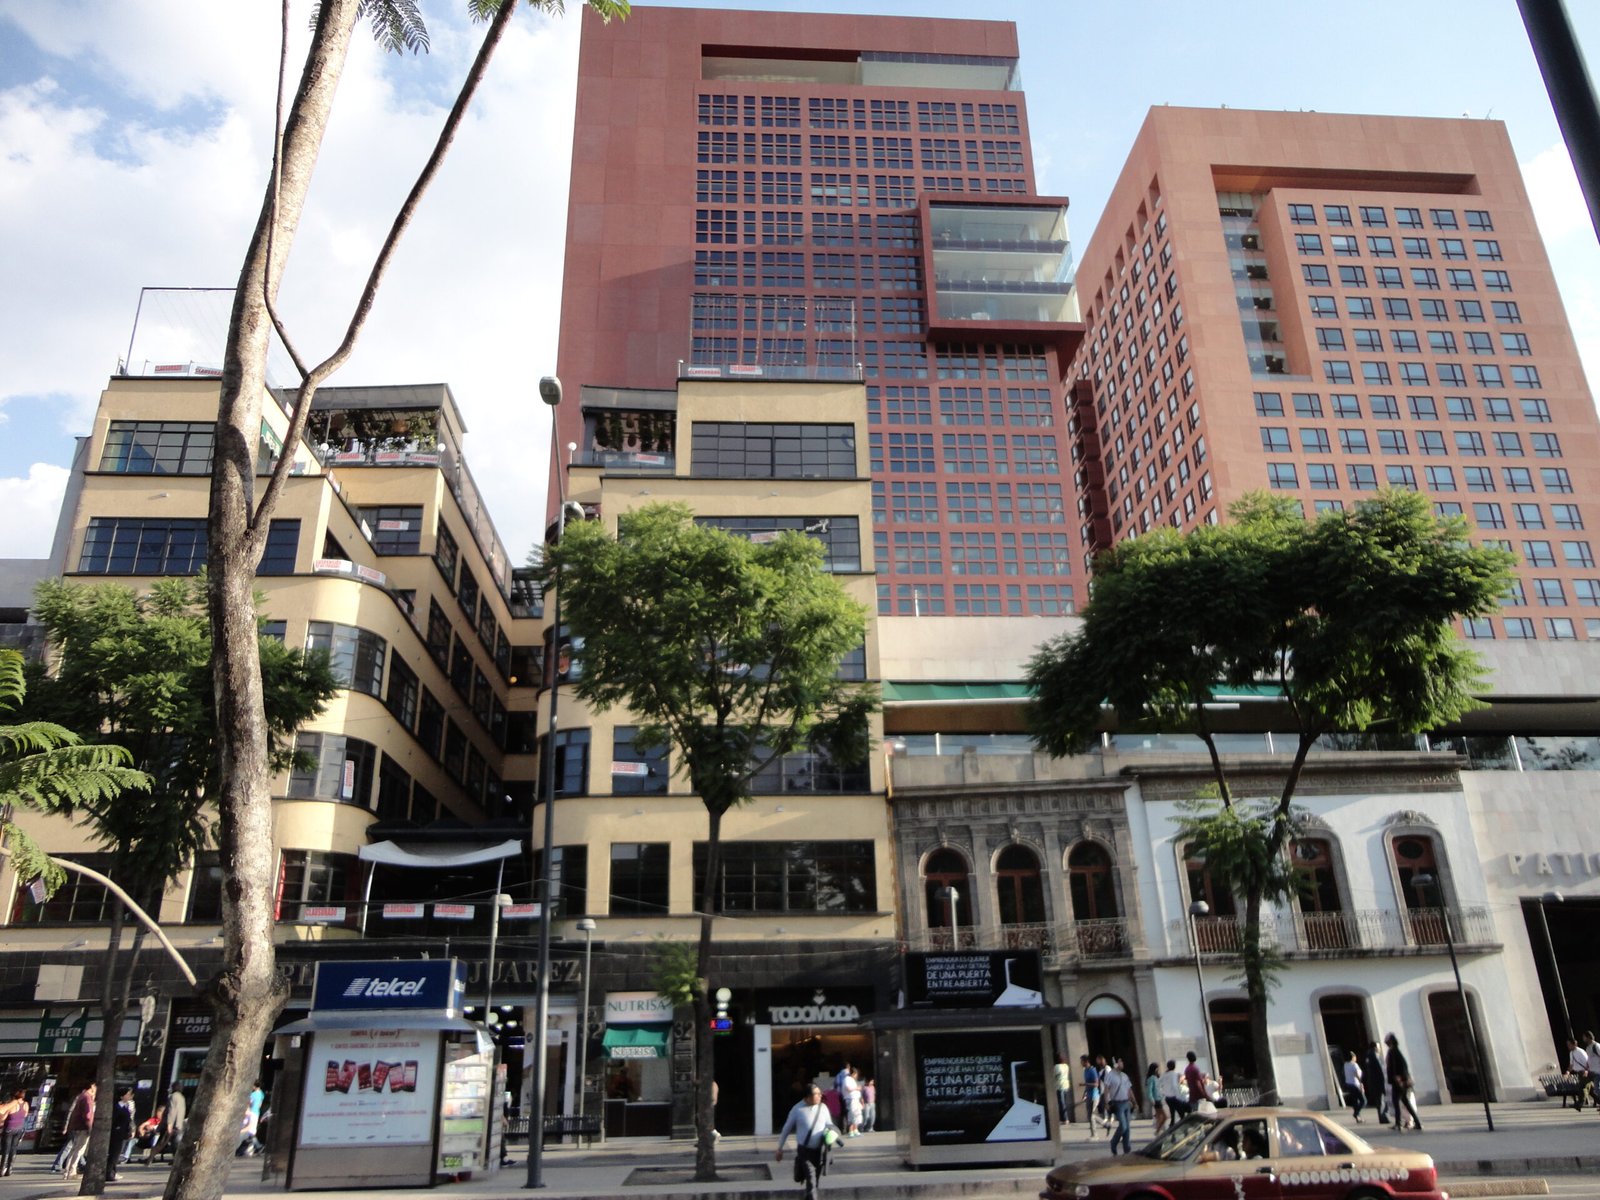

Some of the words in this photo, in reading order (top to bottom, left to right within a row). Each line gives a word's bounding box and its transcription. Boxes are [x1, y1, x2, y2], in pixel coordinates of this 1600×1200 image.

[1507, 852, 1600, 875] PATI
[927, 971, 938, 979] DE
[939, 970, 957, 979] UNA
[958, 969, 991, 978] PUERTA
[364, 977, 427, 996] telcel
[607, 1000, 667, 1012] NUTRISA
[768, 1005, 860, 1023] TODOMODA
[176, 1016, 211, 1024] STARB
[185, 1025, 212, 1033] COFF
[612, 1047, 658, 1057] NUTRISA
[924, 1057, 965, 1065] EMPRENDER
[925, 1066, 946, 1074] SABER
[926, 1075, 939, 1086] DE
[941, 1075, 963, 1085] UNA
[964, 1073, 1004, 1084] PUERTA
